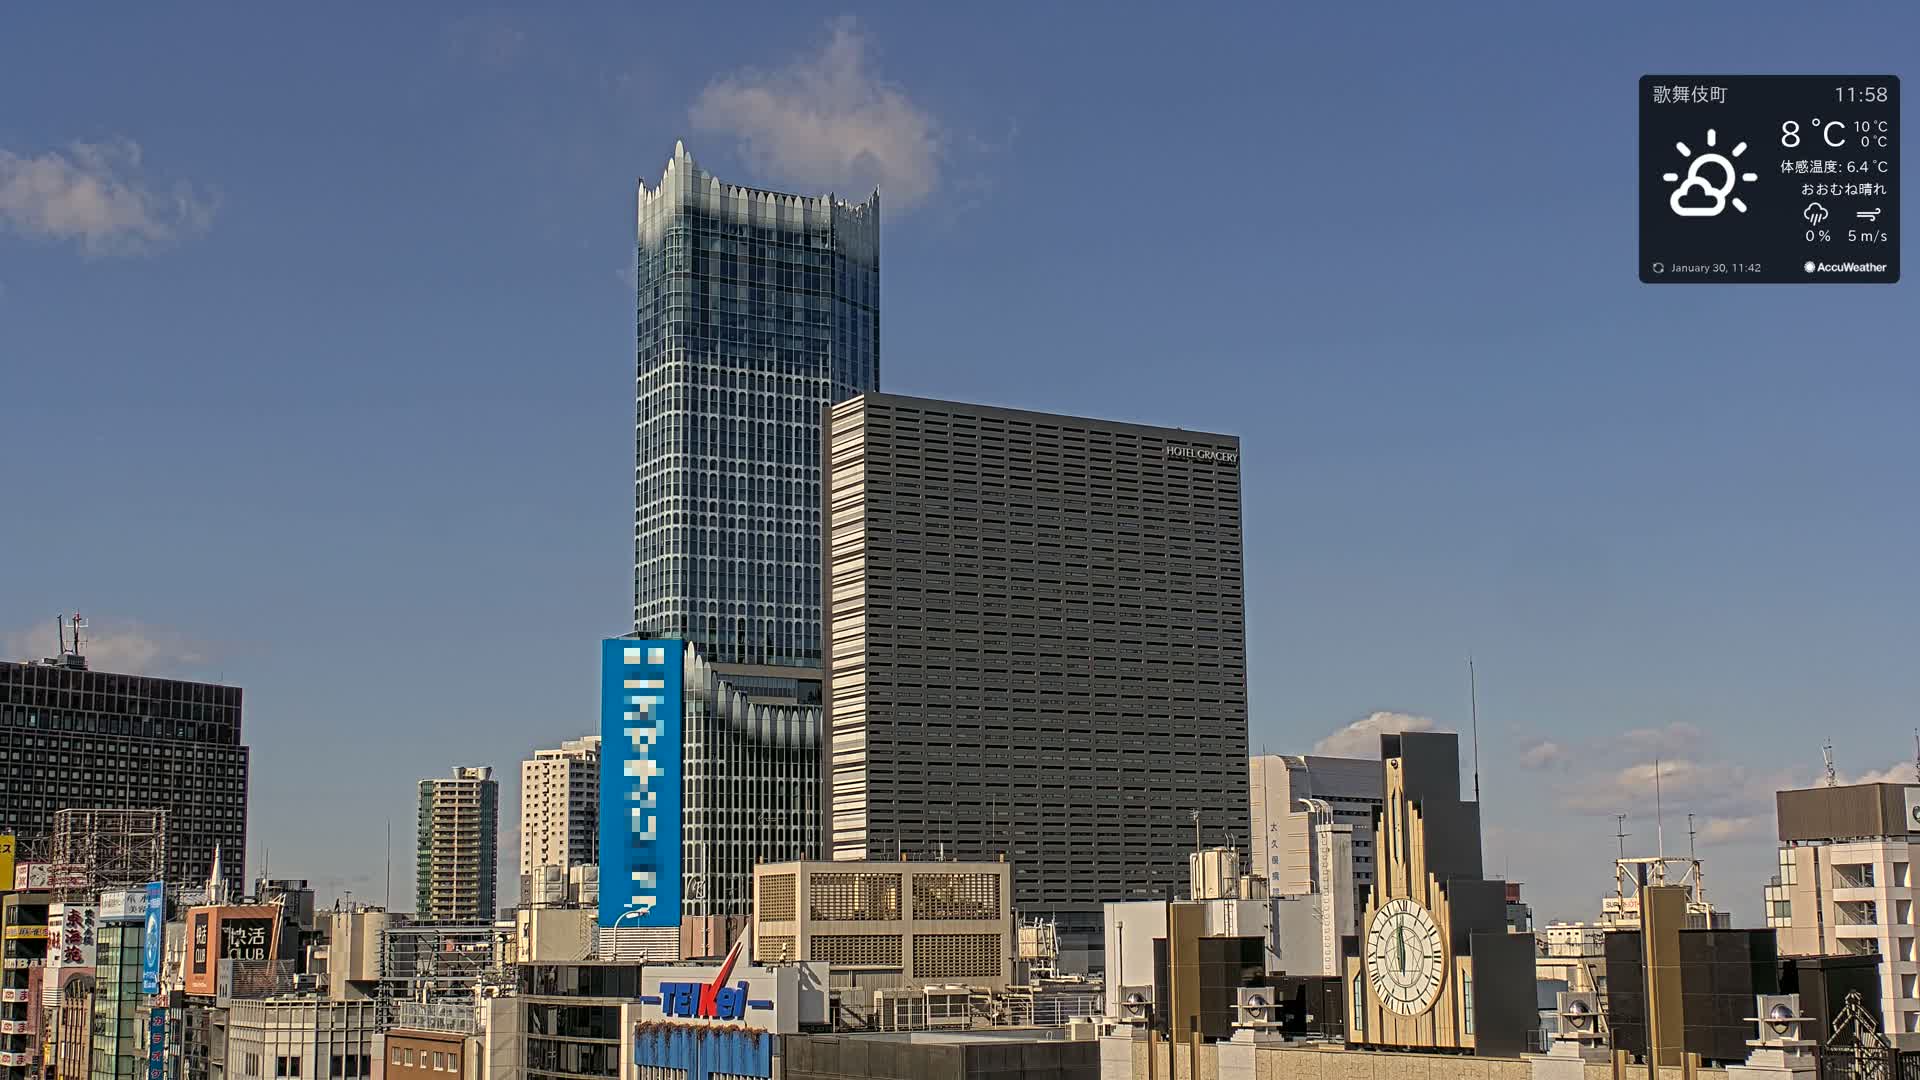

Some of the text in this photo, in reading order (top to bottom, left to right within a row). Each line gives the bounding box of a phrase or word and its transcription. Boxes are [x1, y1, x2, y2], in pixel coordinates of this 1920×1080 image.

[1166, 446, 1238, 462] HOTEL GRACERY
[0, 844, 11, 854] ス
[229, 927, 265, 945] 快活
[229, 948, 265, 960] CLUB
